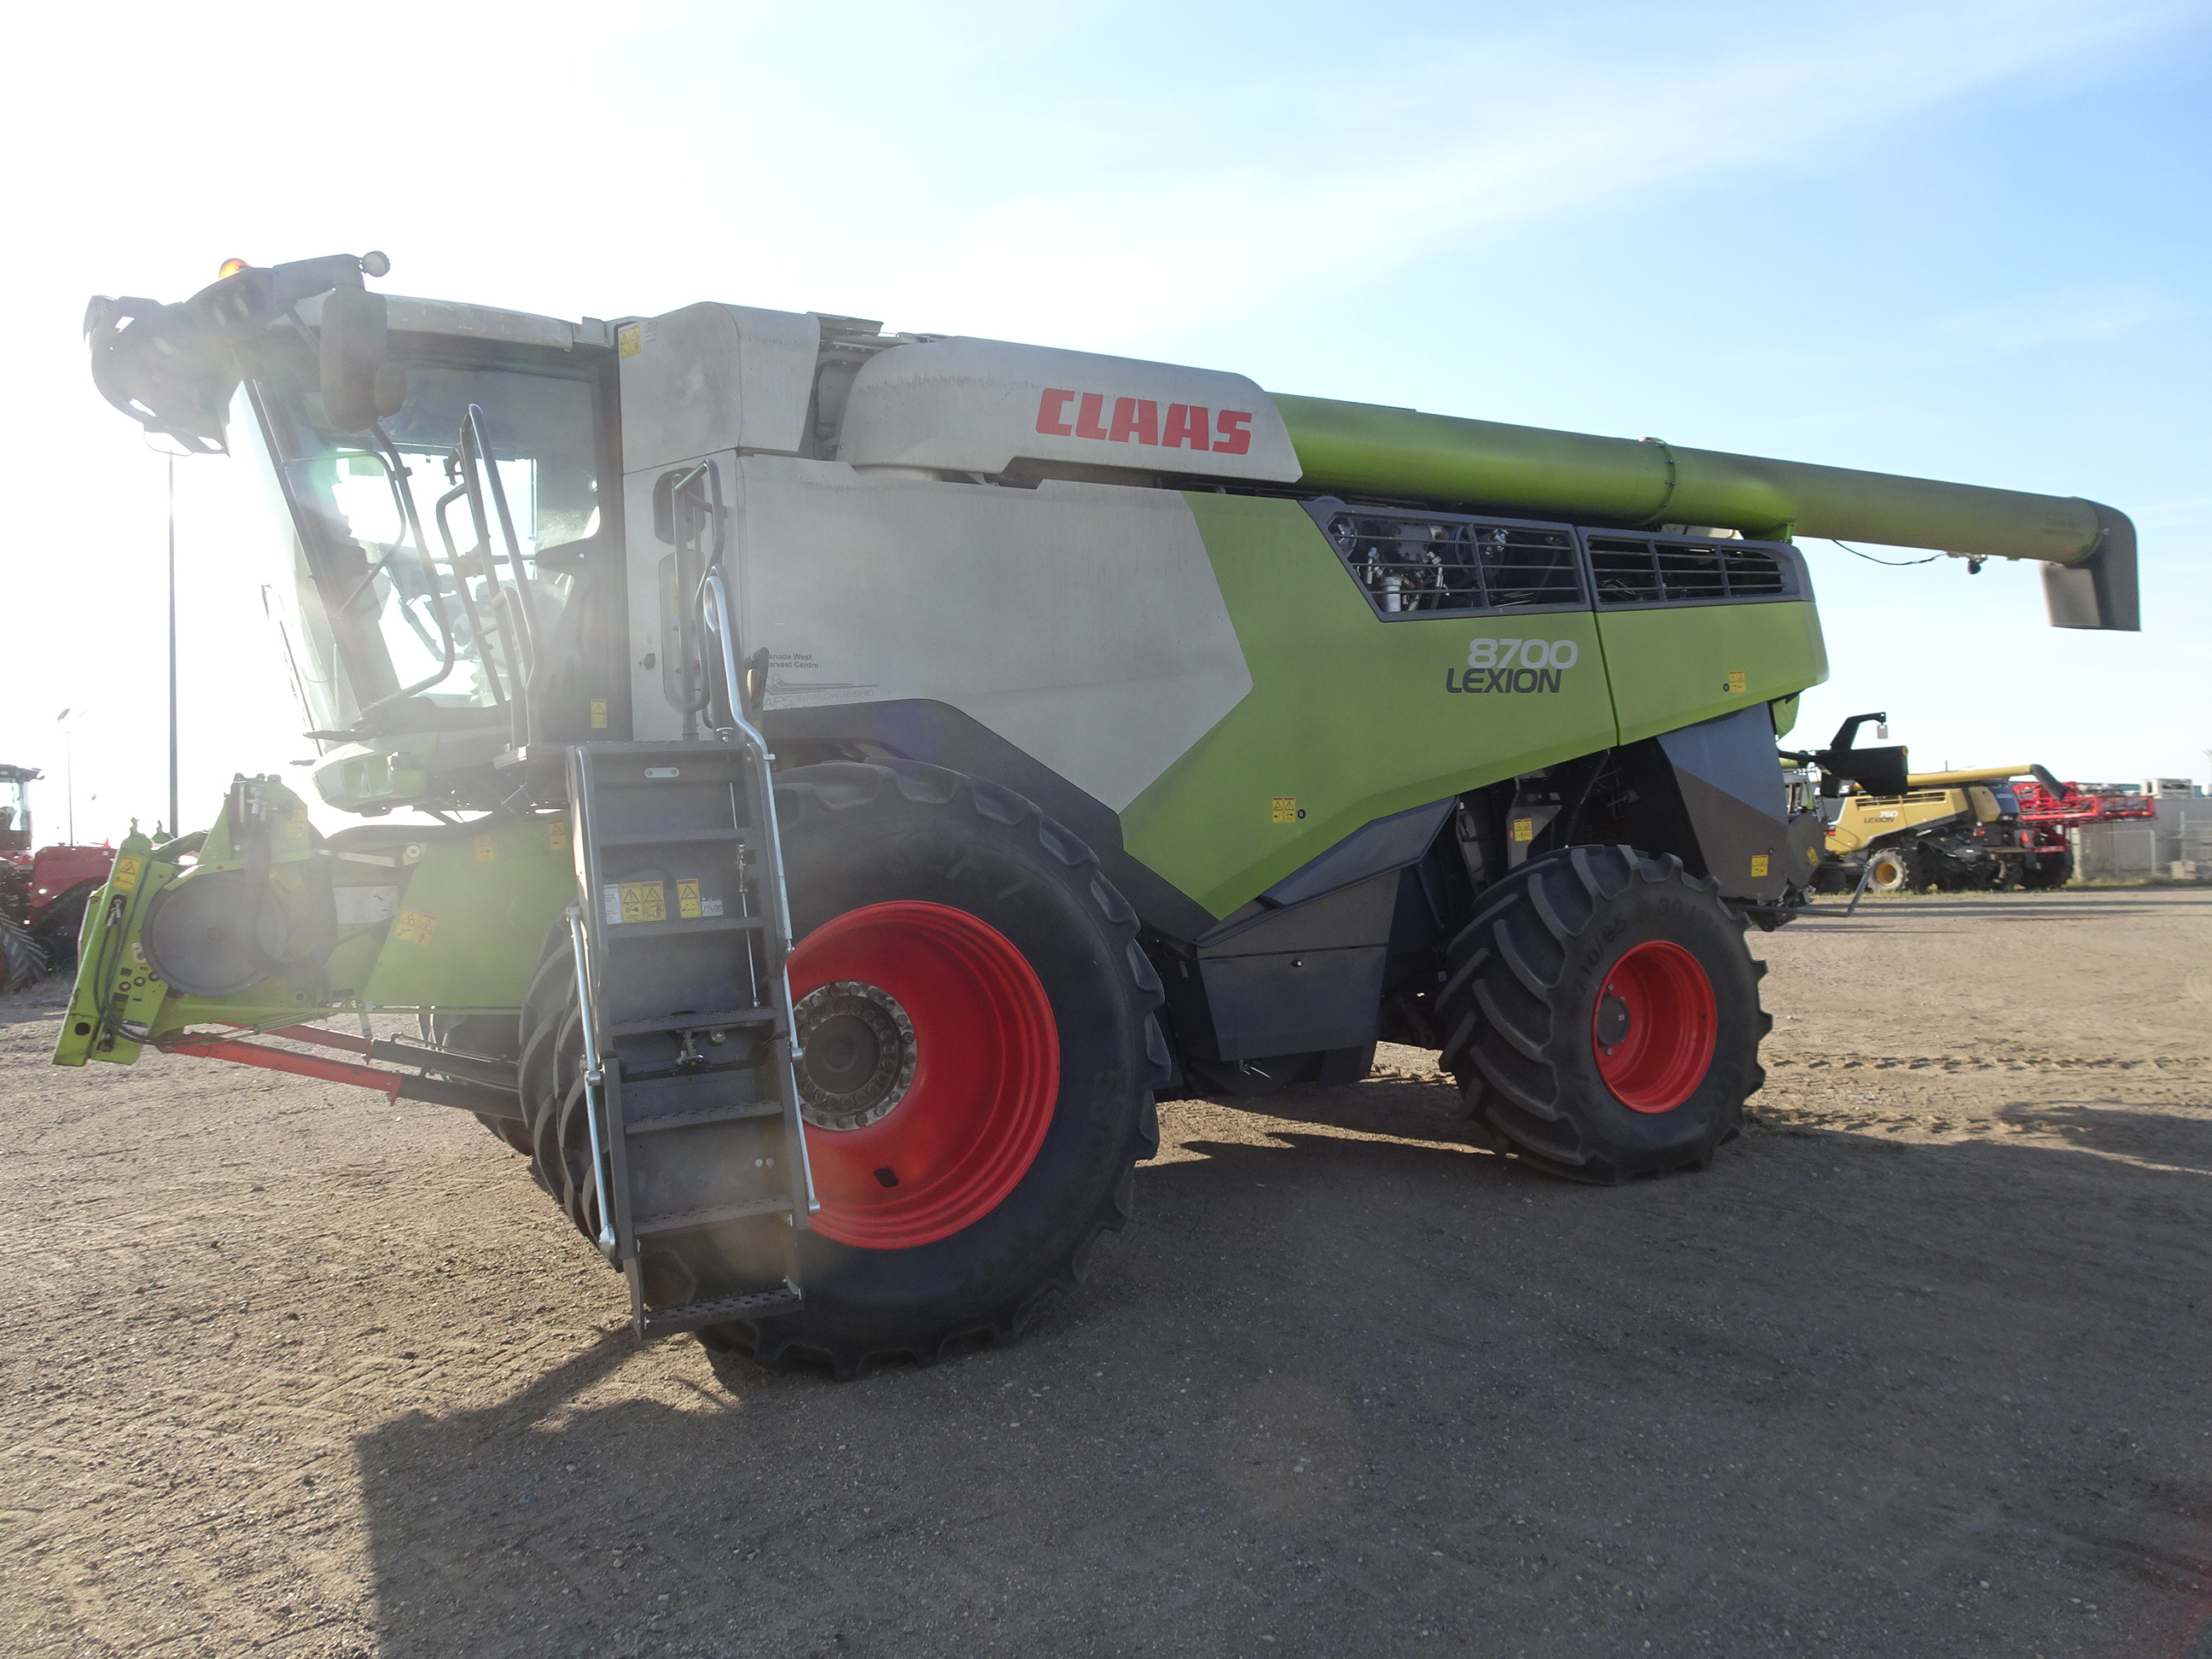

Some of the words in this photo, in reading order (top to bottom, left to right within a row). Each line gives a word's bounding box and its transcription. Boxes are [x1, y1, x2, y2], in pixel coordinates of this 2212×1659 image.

[1035, 387, 1252, 455] CLAAS
[794, 661, 819, 669] Centre
[1467, 637, 1578, 669] 8700
[1446, 668, 1563, 694] LEXION
[1879, 810, 1899, 818] 760
